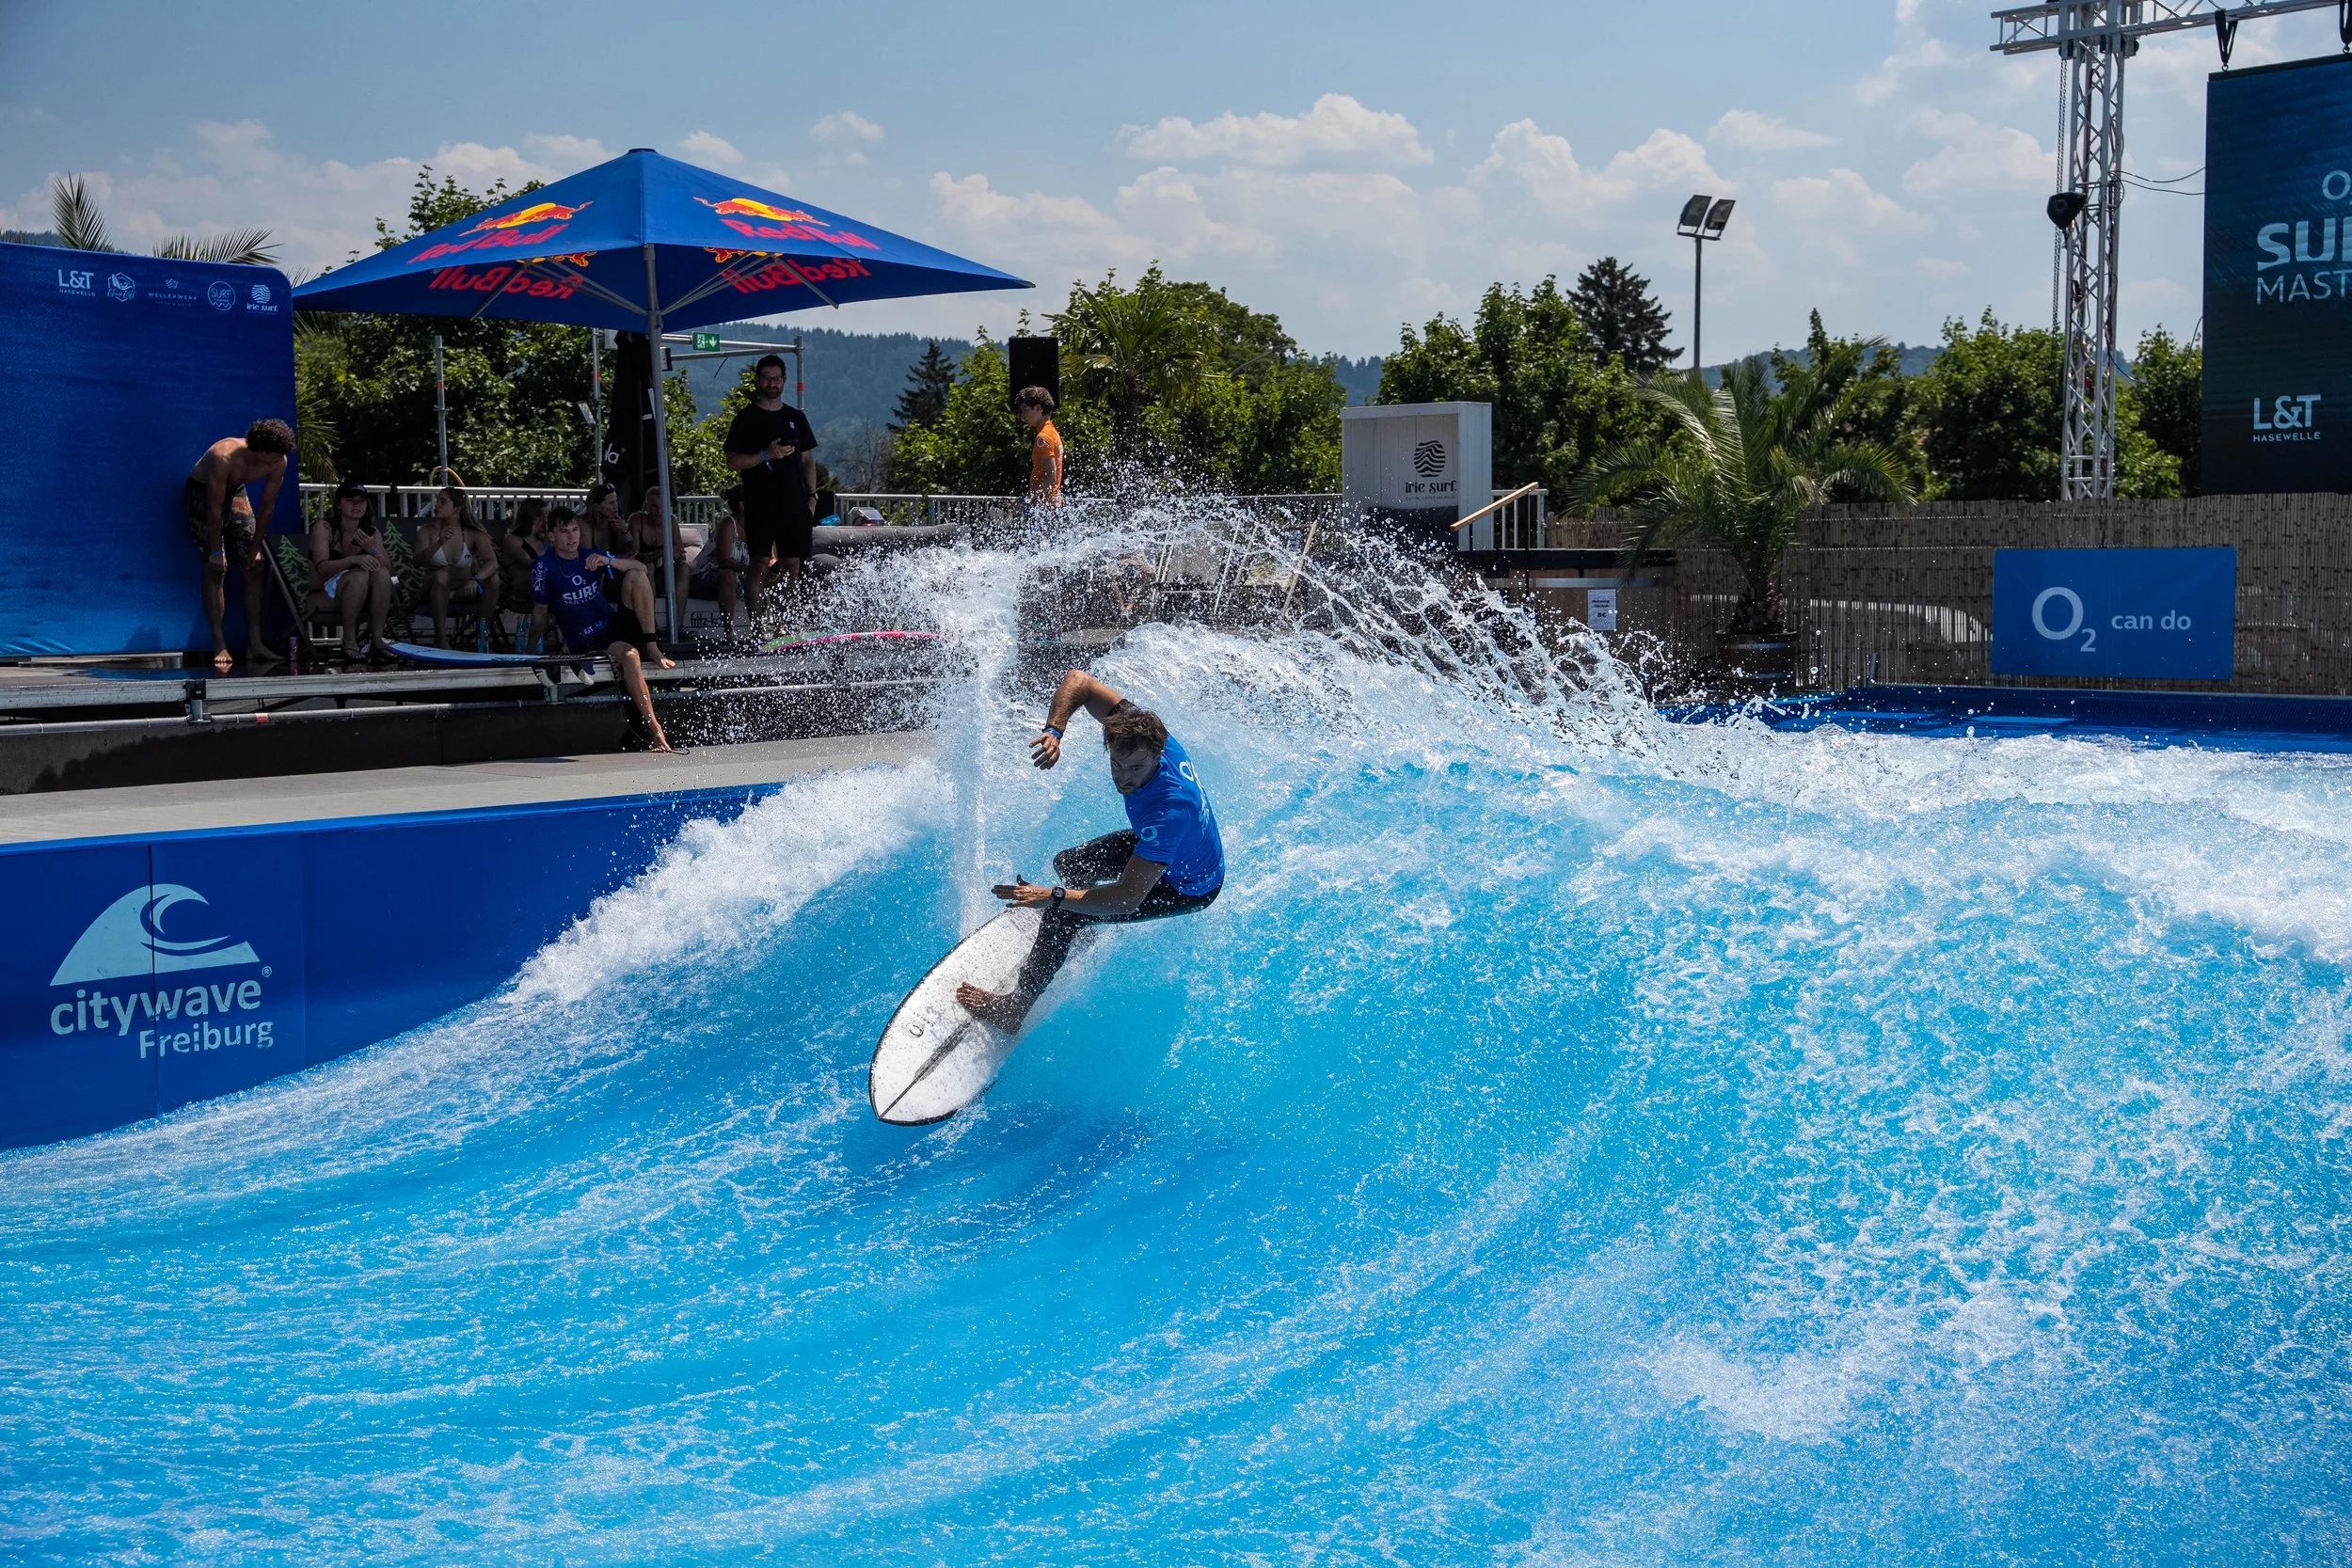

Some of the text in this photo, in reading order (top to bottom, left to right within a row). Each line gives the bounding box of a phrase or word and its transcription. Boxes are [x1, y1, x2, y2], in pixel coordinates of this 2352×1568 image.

[2322, 169, 2352, 205] O
[58, 269, 94, 290] L&T
[59, 288, 96, 297] HASEWELLE
[211, 288, 231, 299] SURF
[2253, 394, 2322, 430] L&T
[2253, 432, 2321, 443] HASEWELLE
[1405, 481, 1425, 494] irie
[563, 580, 597, 601] SURF
[690, 612, 723, 626] fritz-ko
[2031, 586, 2192, 652] O2 can do
[139, 1022, 274, 1058] Freiburg
